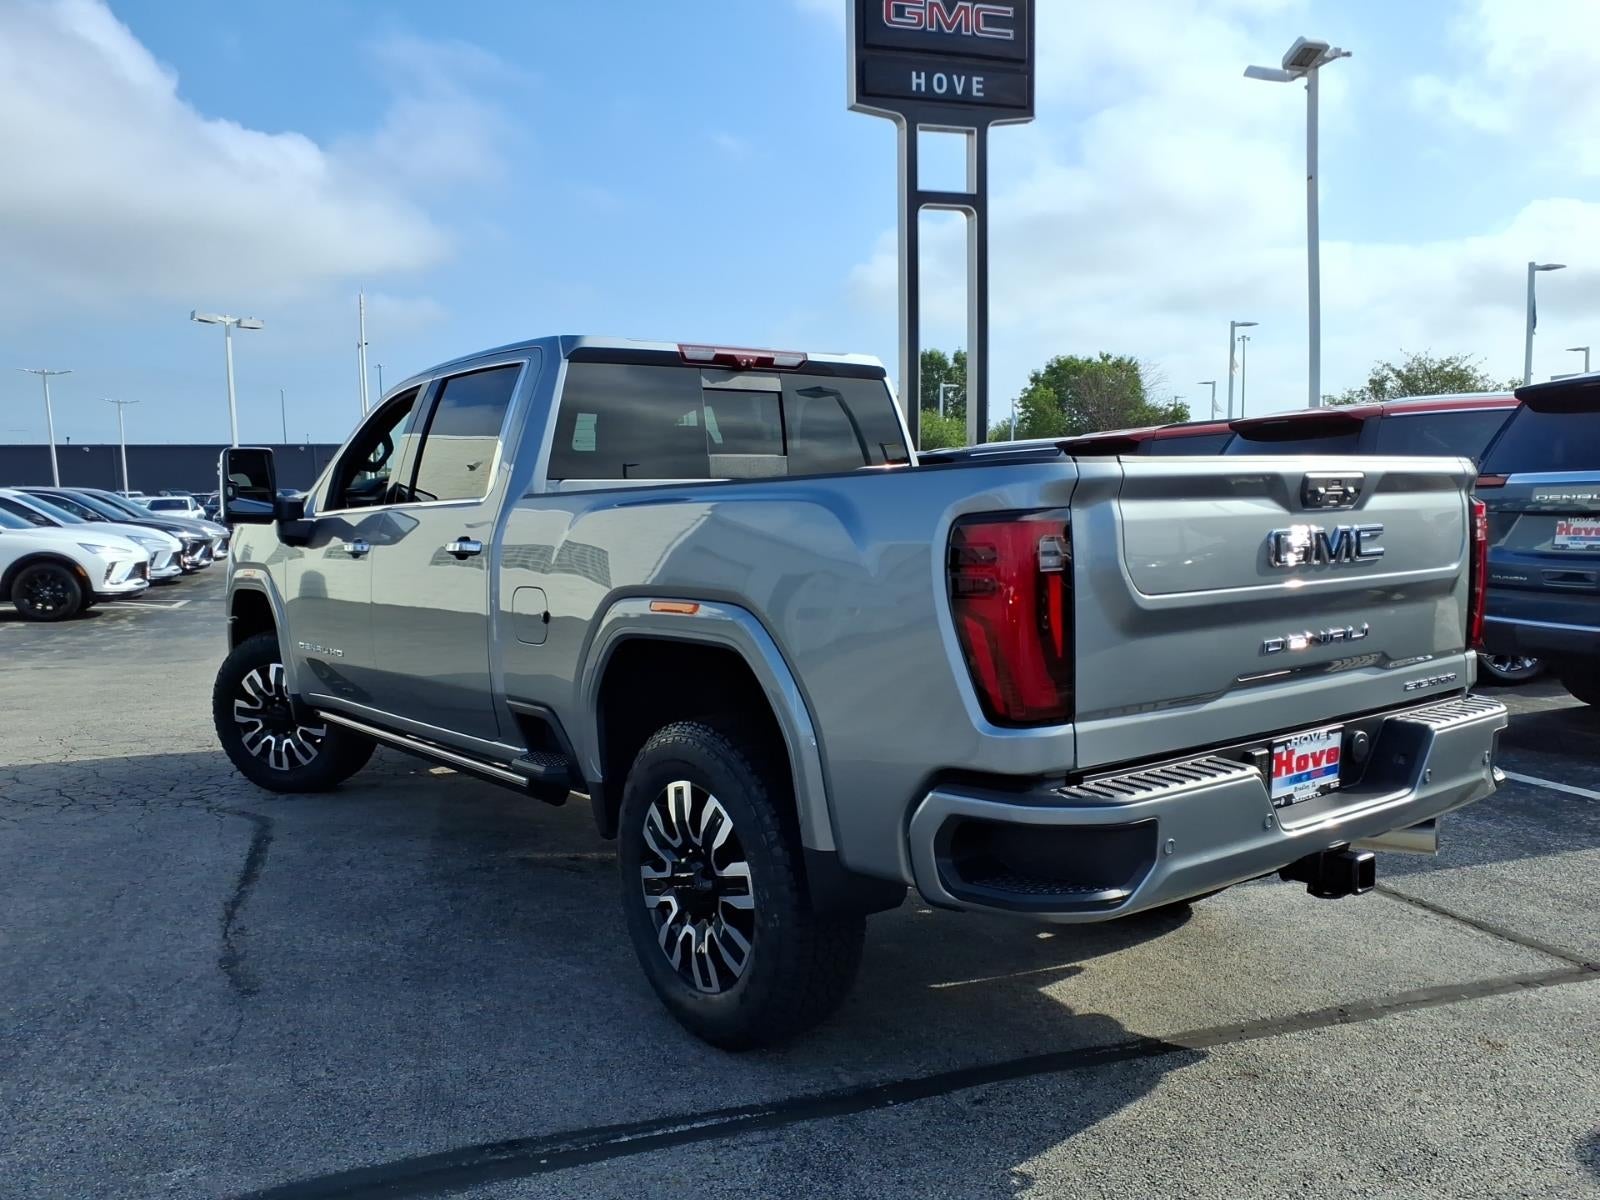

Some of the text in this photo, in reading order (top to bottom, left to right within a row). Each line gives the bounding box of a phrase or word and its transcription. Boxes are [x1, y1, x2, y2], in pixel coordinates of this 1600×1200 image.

[883, 0, 1015, 40] GMC
[911, 71, 985, 97] HOVE
[1268, 523, 1385, 568] GMC
[1263, 621, 1370, 654] DENALI
[1291, 731, 1328, 747] HOVE
[1273, 746, 1340, 778] Hove
